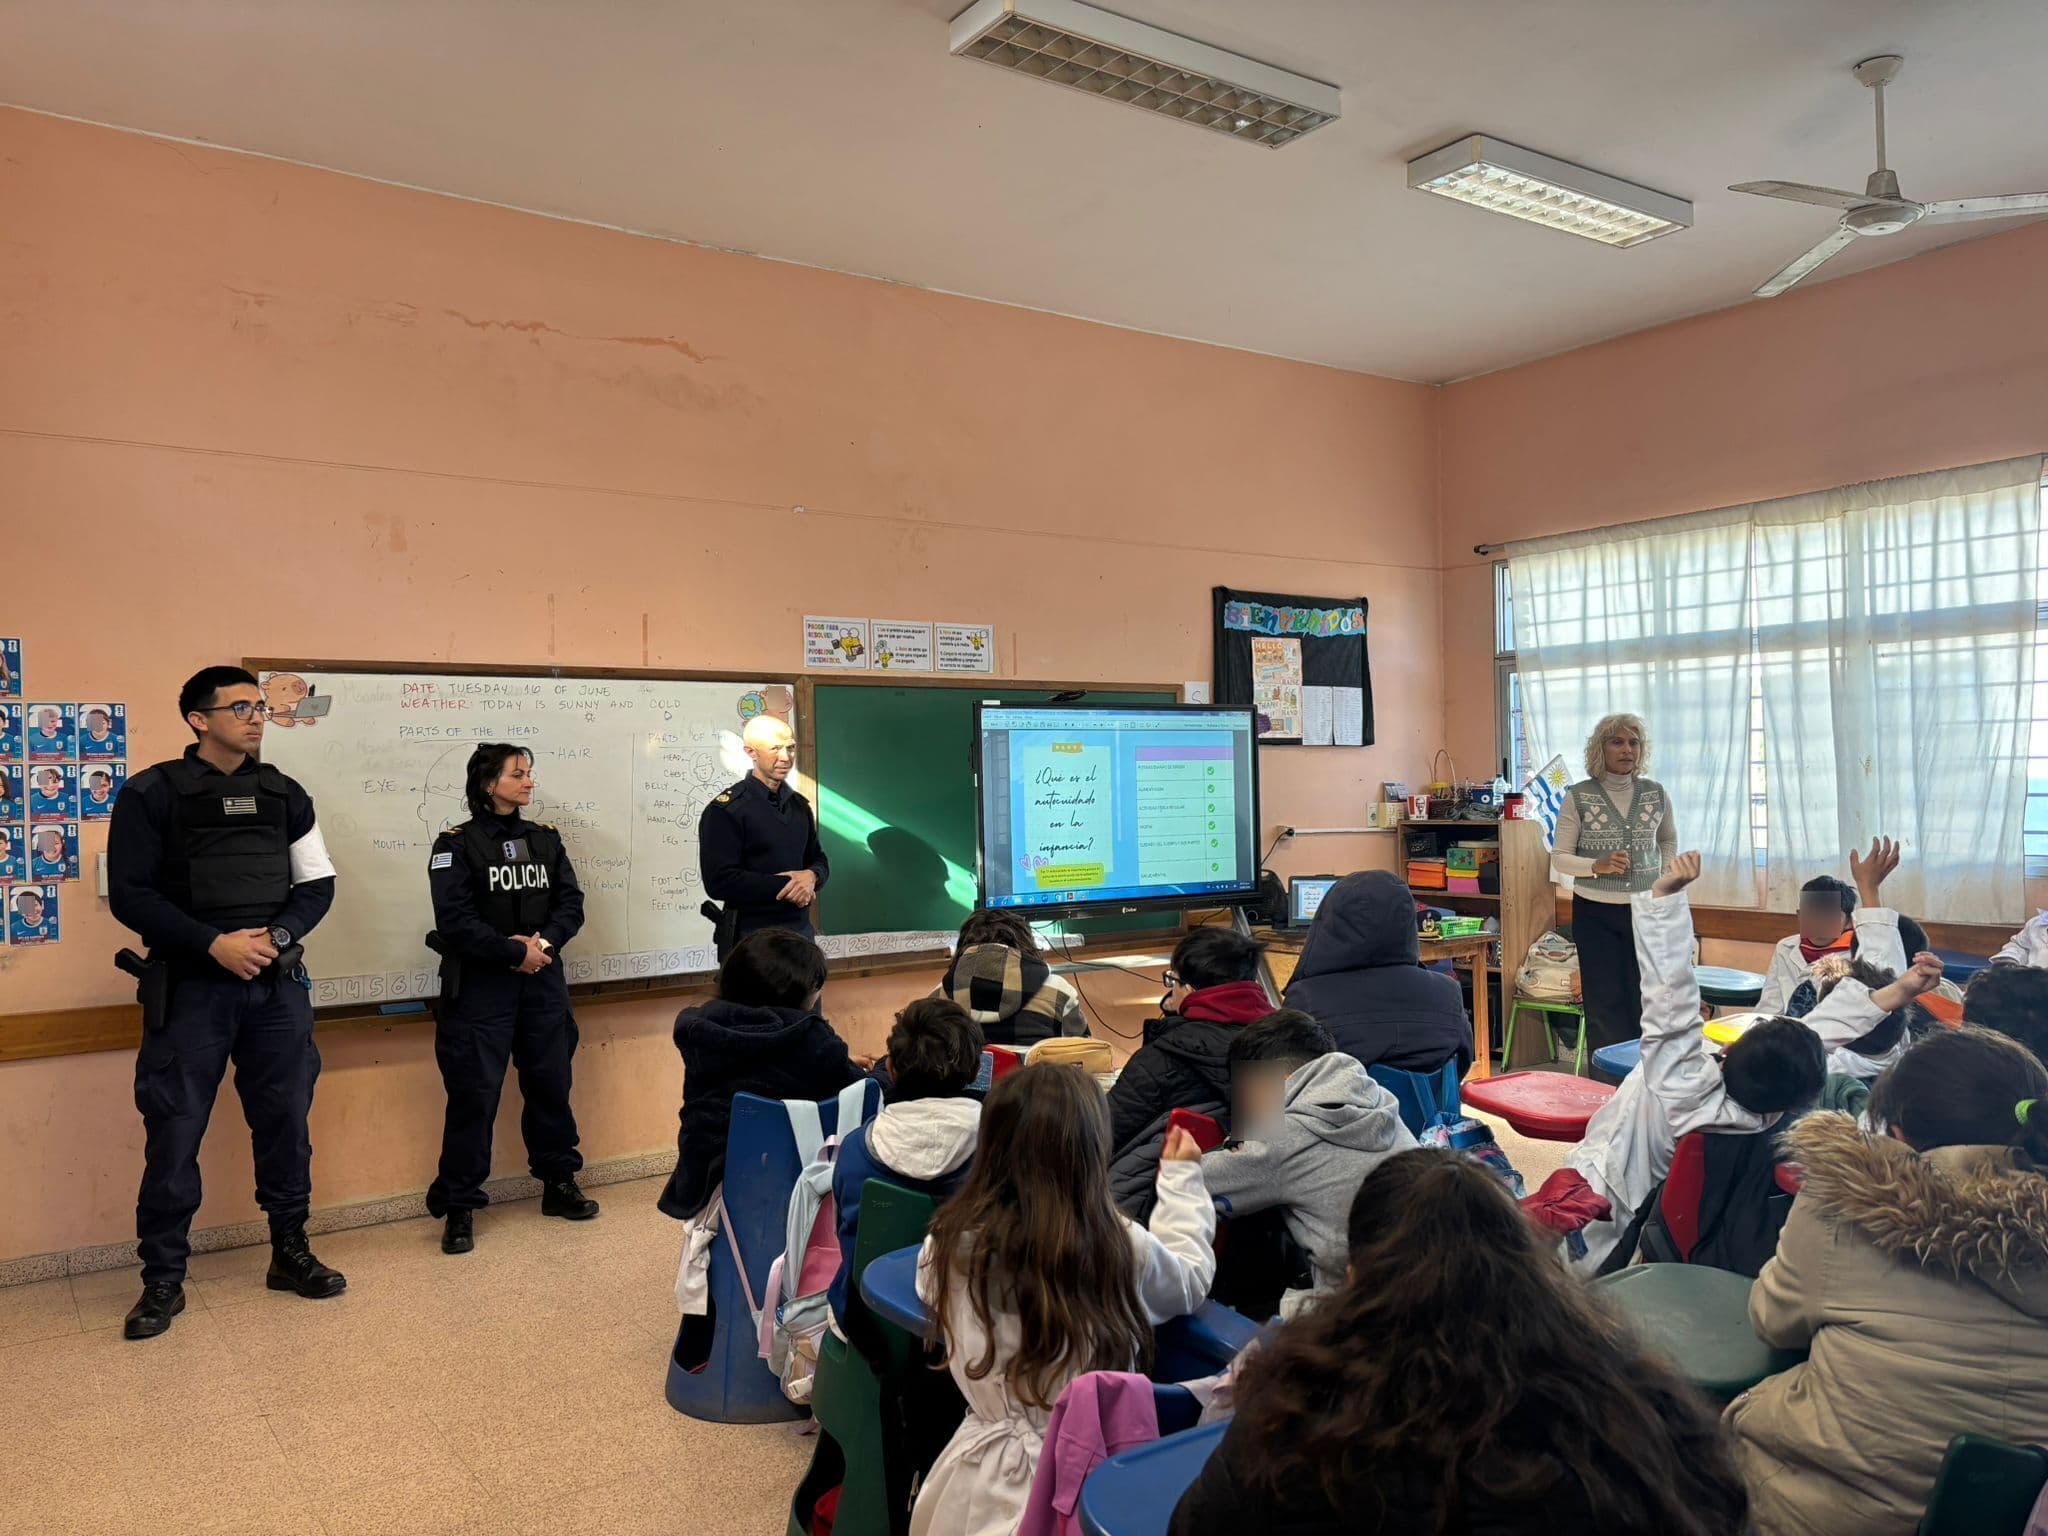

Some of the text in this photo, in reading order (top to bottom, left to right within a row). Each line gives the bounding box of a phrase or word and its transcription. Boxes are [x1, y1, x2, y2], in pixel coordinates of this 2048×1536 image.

[554, 685, 567, 694] OF
[579, 685, 611, 696] JUNE
[480, 700, 522, 710] TODAY
[535, 700, 546, 709] IS
[559, 700, 600, 709] SUNNY
[610, 700, 634, 708] AND
[649, 700, 680, 709] COLD
[400, 726, 540, 738] PARTS OF THE HEAD
[558, 747, 592, 759] HAIR
[1085, 765, 1098, 783] el
[364, 779, 397, 793] EYE
[562, 801, 600, 812] EAR
[1034, 789, 1096, 810] autocuidado
[556, 818, 600, 829] CHEEK
[1049, 810, 1084, 829] en la
[372, 839, 406, 849] MOUTH
[1039, 837, 1094, 858] infancia?
[489, 864, 550, 891] POLICIA
[820, 939, 840, 954] 22
[848, 936, 872, 953] 23
[880, 936, 898, 950] 24
[569, 960, 592, 979] 13
[602, 958, 621, 976] 14
[631, 955, 650, 974] 15
[659, 952, 680, 970] 16
[687, 950, 706, 968] 17
[319, 973, 429, 1000] 3 4 5 6 7
